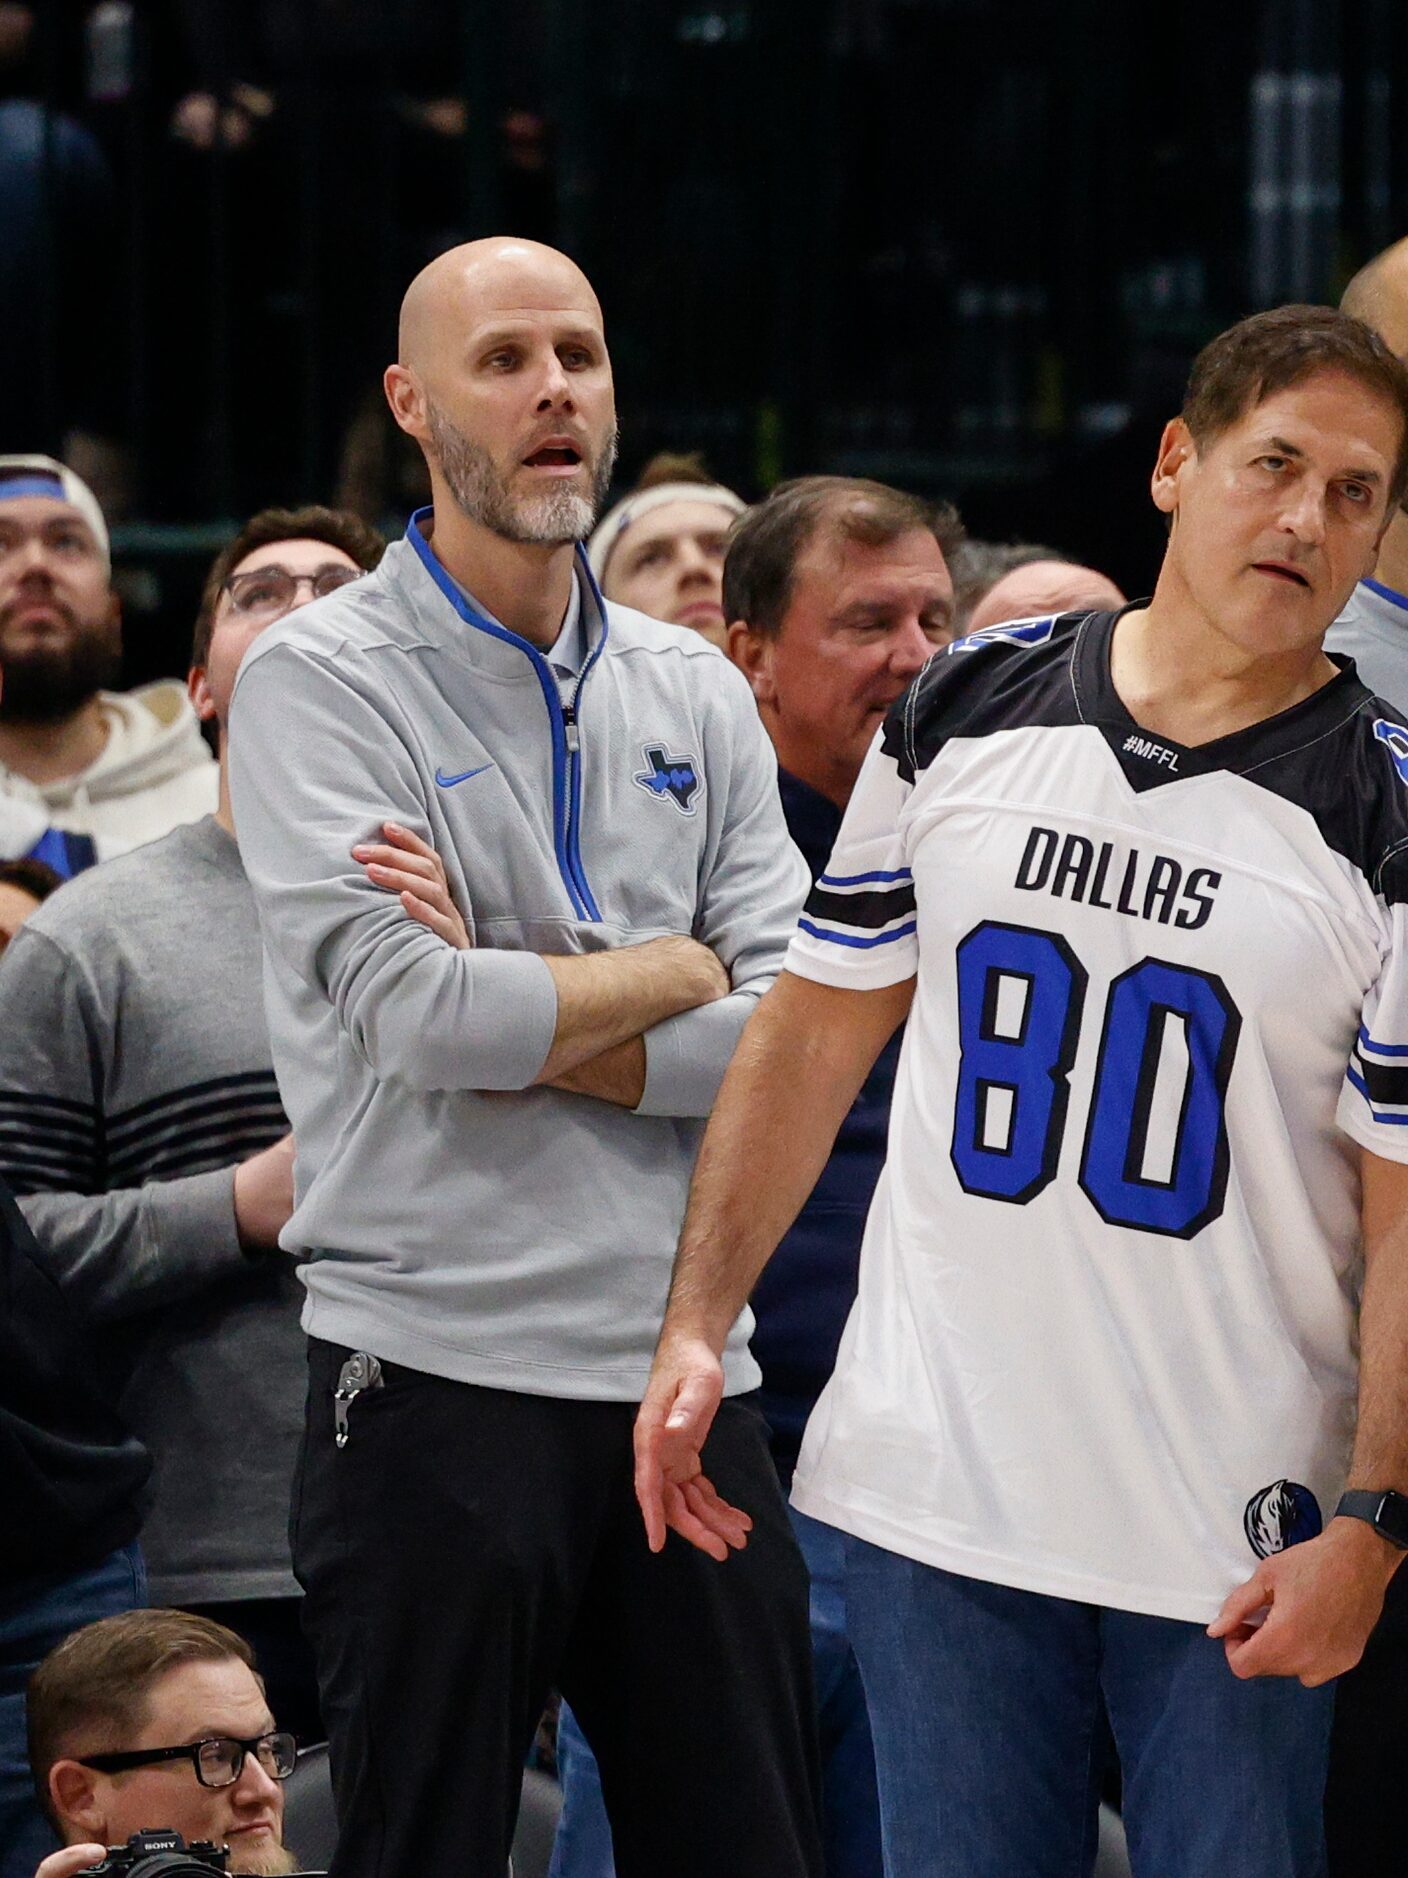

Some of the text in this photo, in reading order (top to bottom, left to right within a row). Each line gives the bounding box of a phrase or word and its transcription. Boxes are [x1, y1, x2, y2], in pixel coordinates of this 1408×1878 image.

[1122, 735, 1179, 772] #MFFL
[1014, 826, 1222, 930] DALLAS
[949, 919, 1243, 1241] 80
[144, 1841, 176, 1850] SONY
